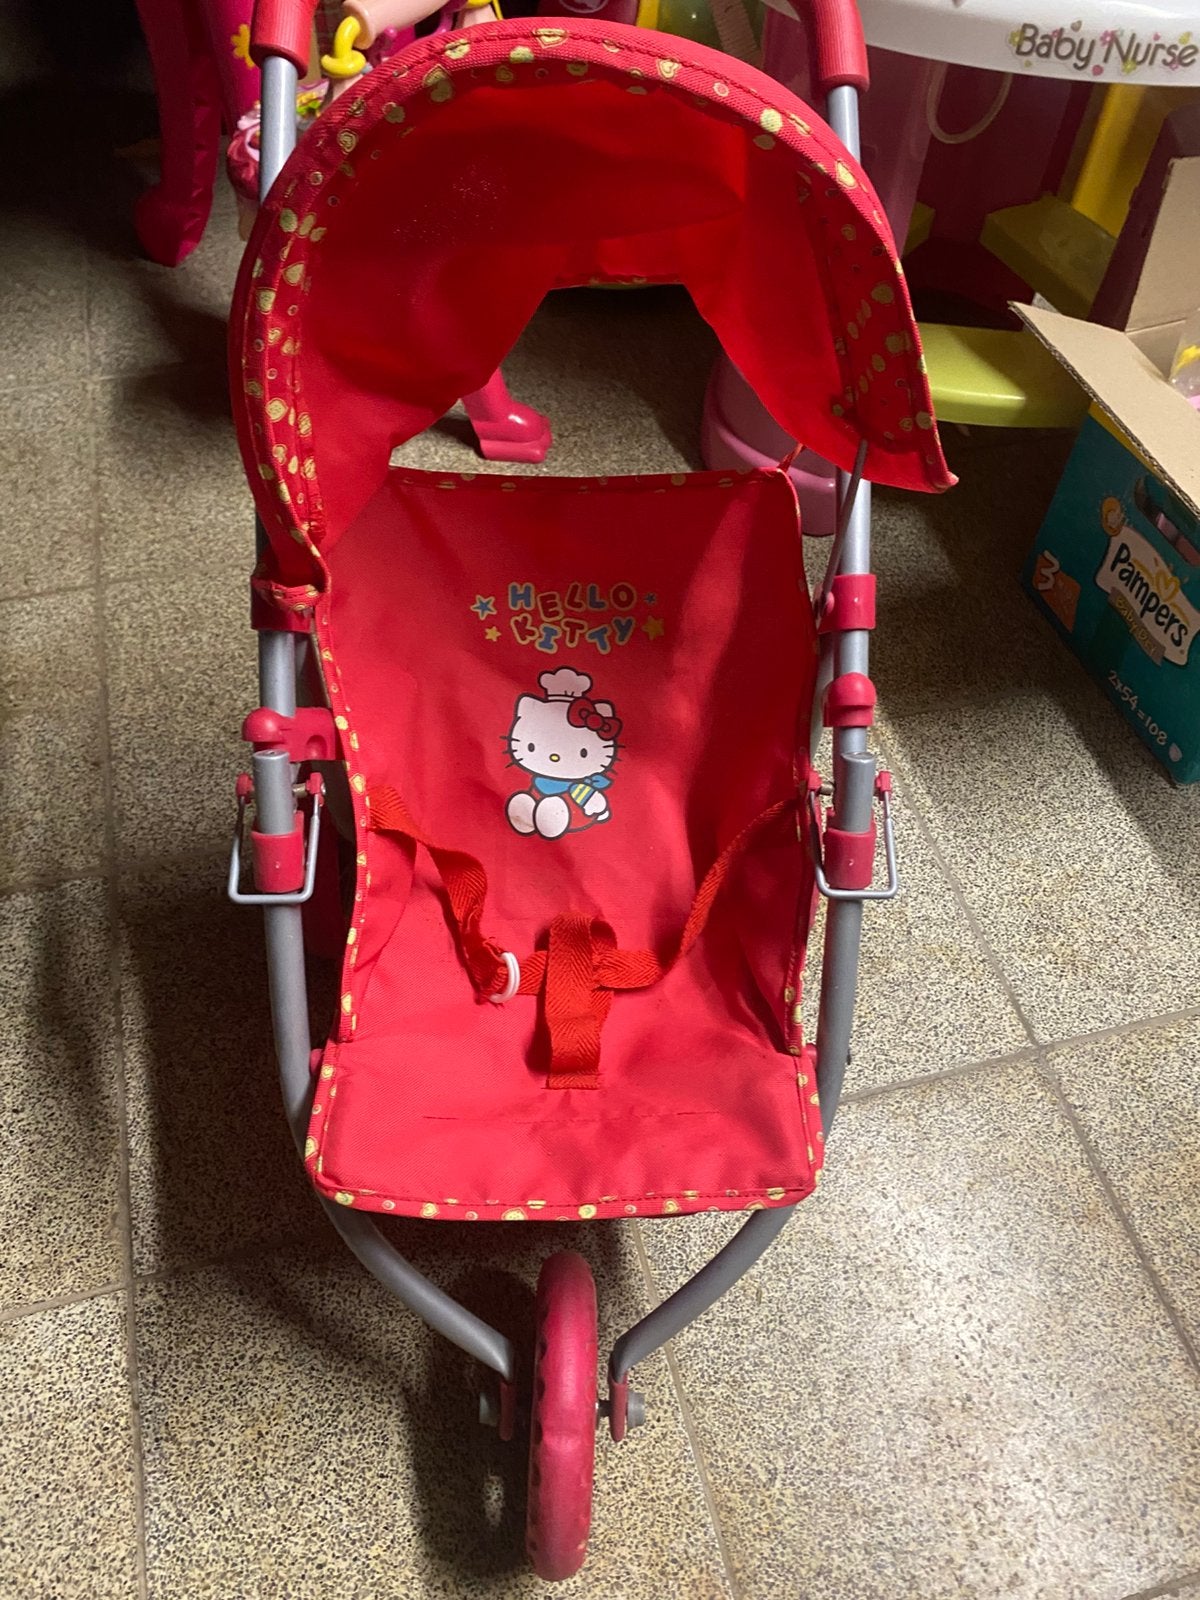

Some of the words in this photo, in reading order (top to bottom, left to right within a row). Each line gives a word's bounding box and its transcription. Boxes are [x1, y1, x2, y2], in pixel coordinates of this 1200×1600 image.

[1015, 23, 1095, 71] Baby
[1103, 31, 1199, 67] Nurse
[1038, 550, 1060, 591] 3
[508, 582, 637, 622] HELLO
[1110, 543, 1188, 648] Pampers
[510, 613, 635, 655] KITTY
